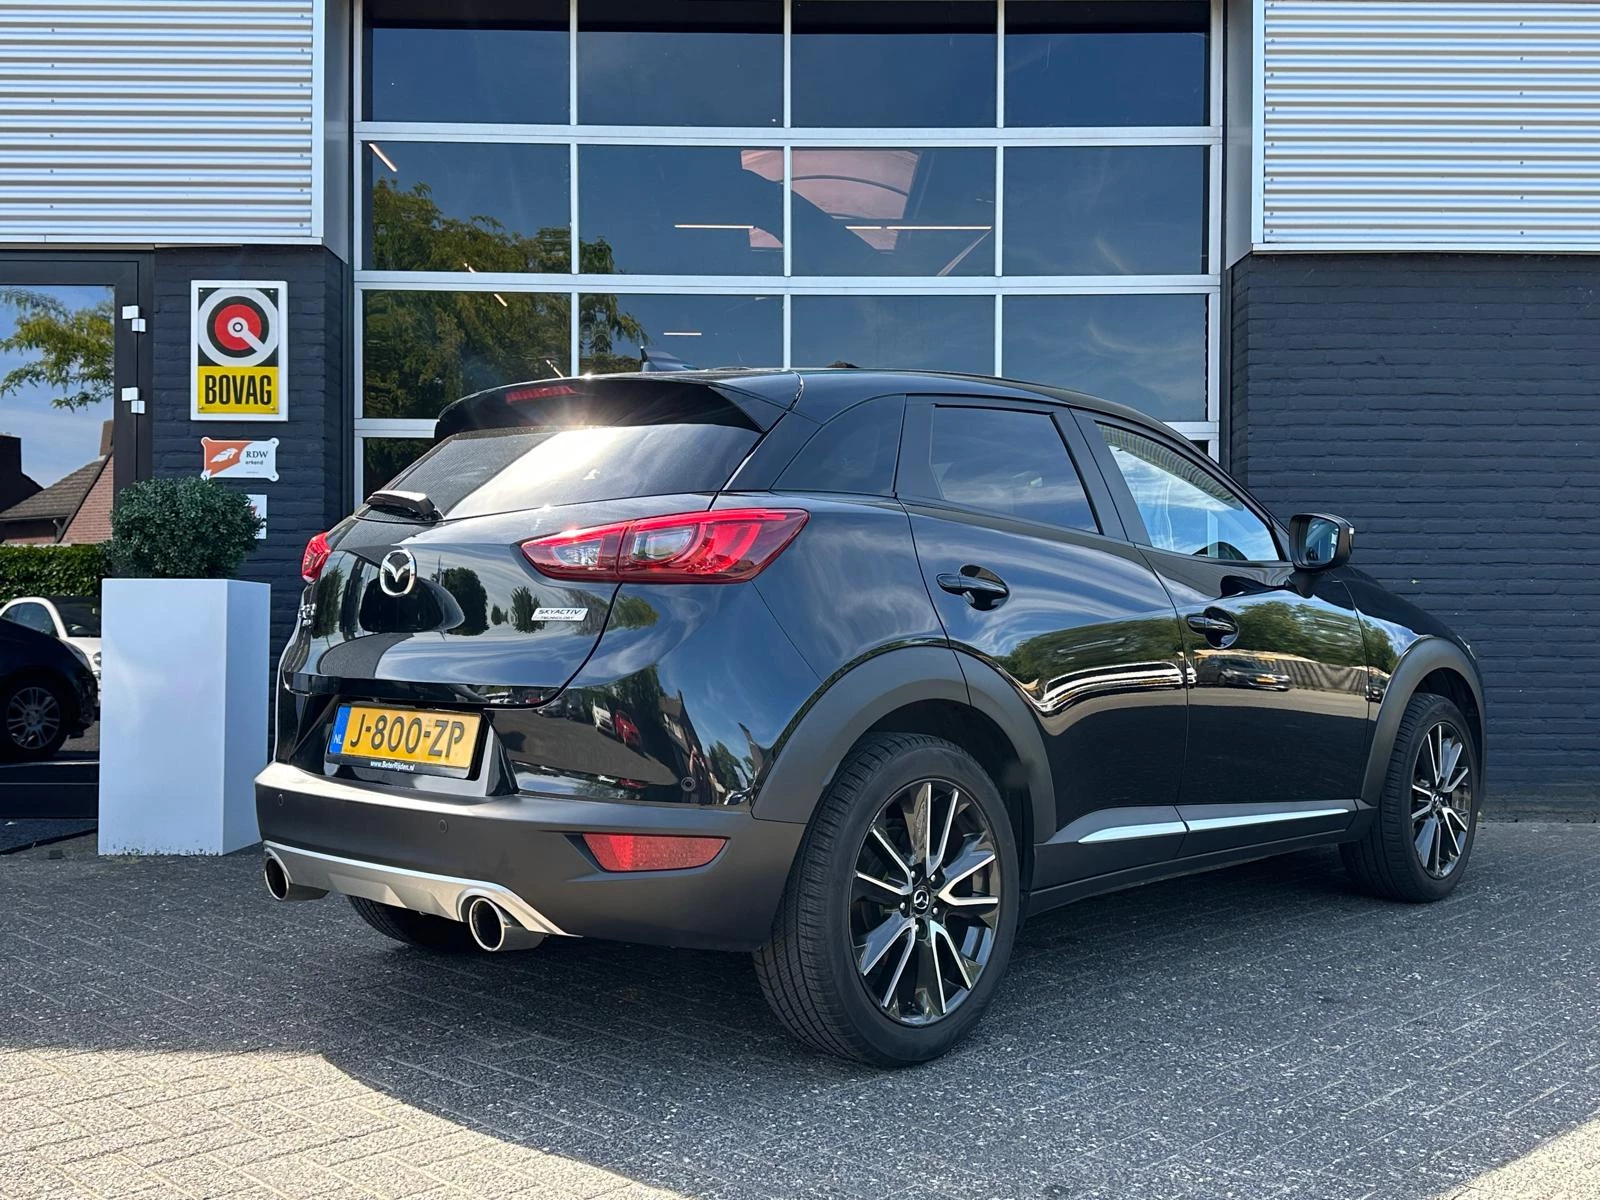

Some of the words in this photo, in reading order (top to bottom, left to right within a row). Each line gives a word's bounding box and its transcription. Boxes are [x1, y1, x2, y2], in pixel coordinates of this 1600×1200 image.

[205, 374, 272, 405] BOVAG
[246, 450, 269, 459] RDW
[333, 733, 343, 745] NL
[349, 713, 465, 759] J-800-ZP
